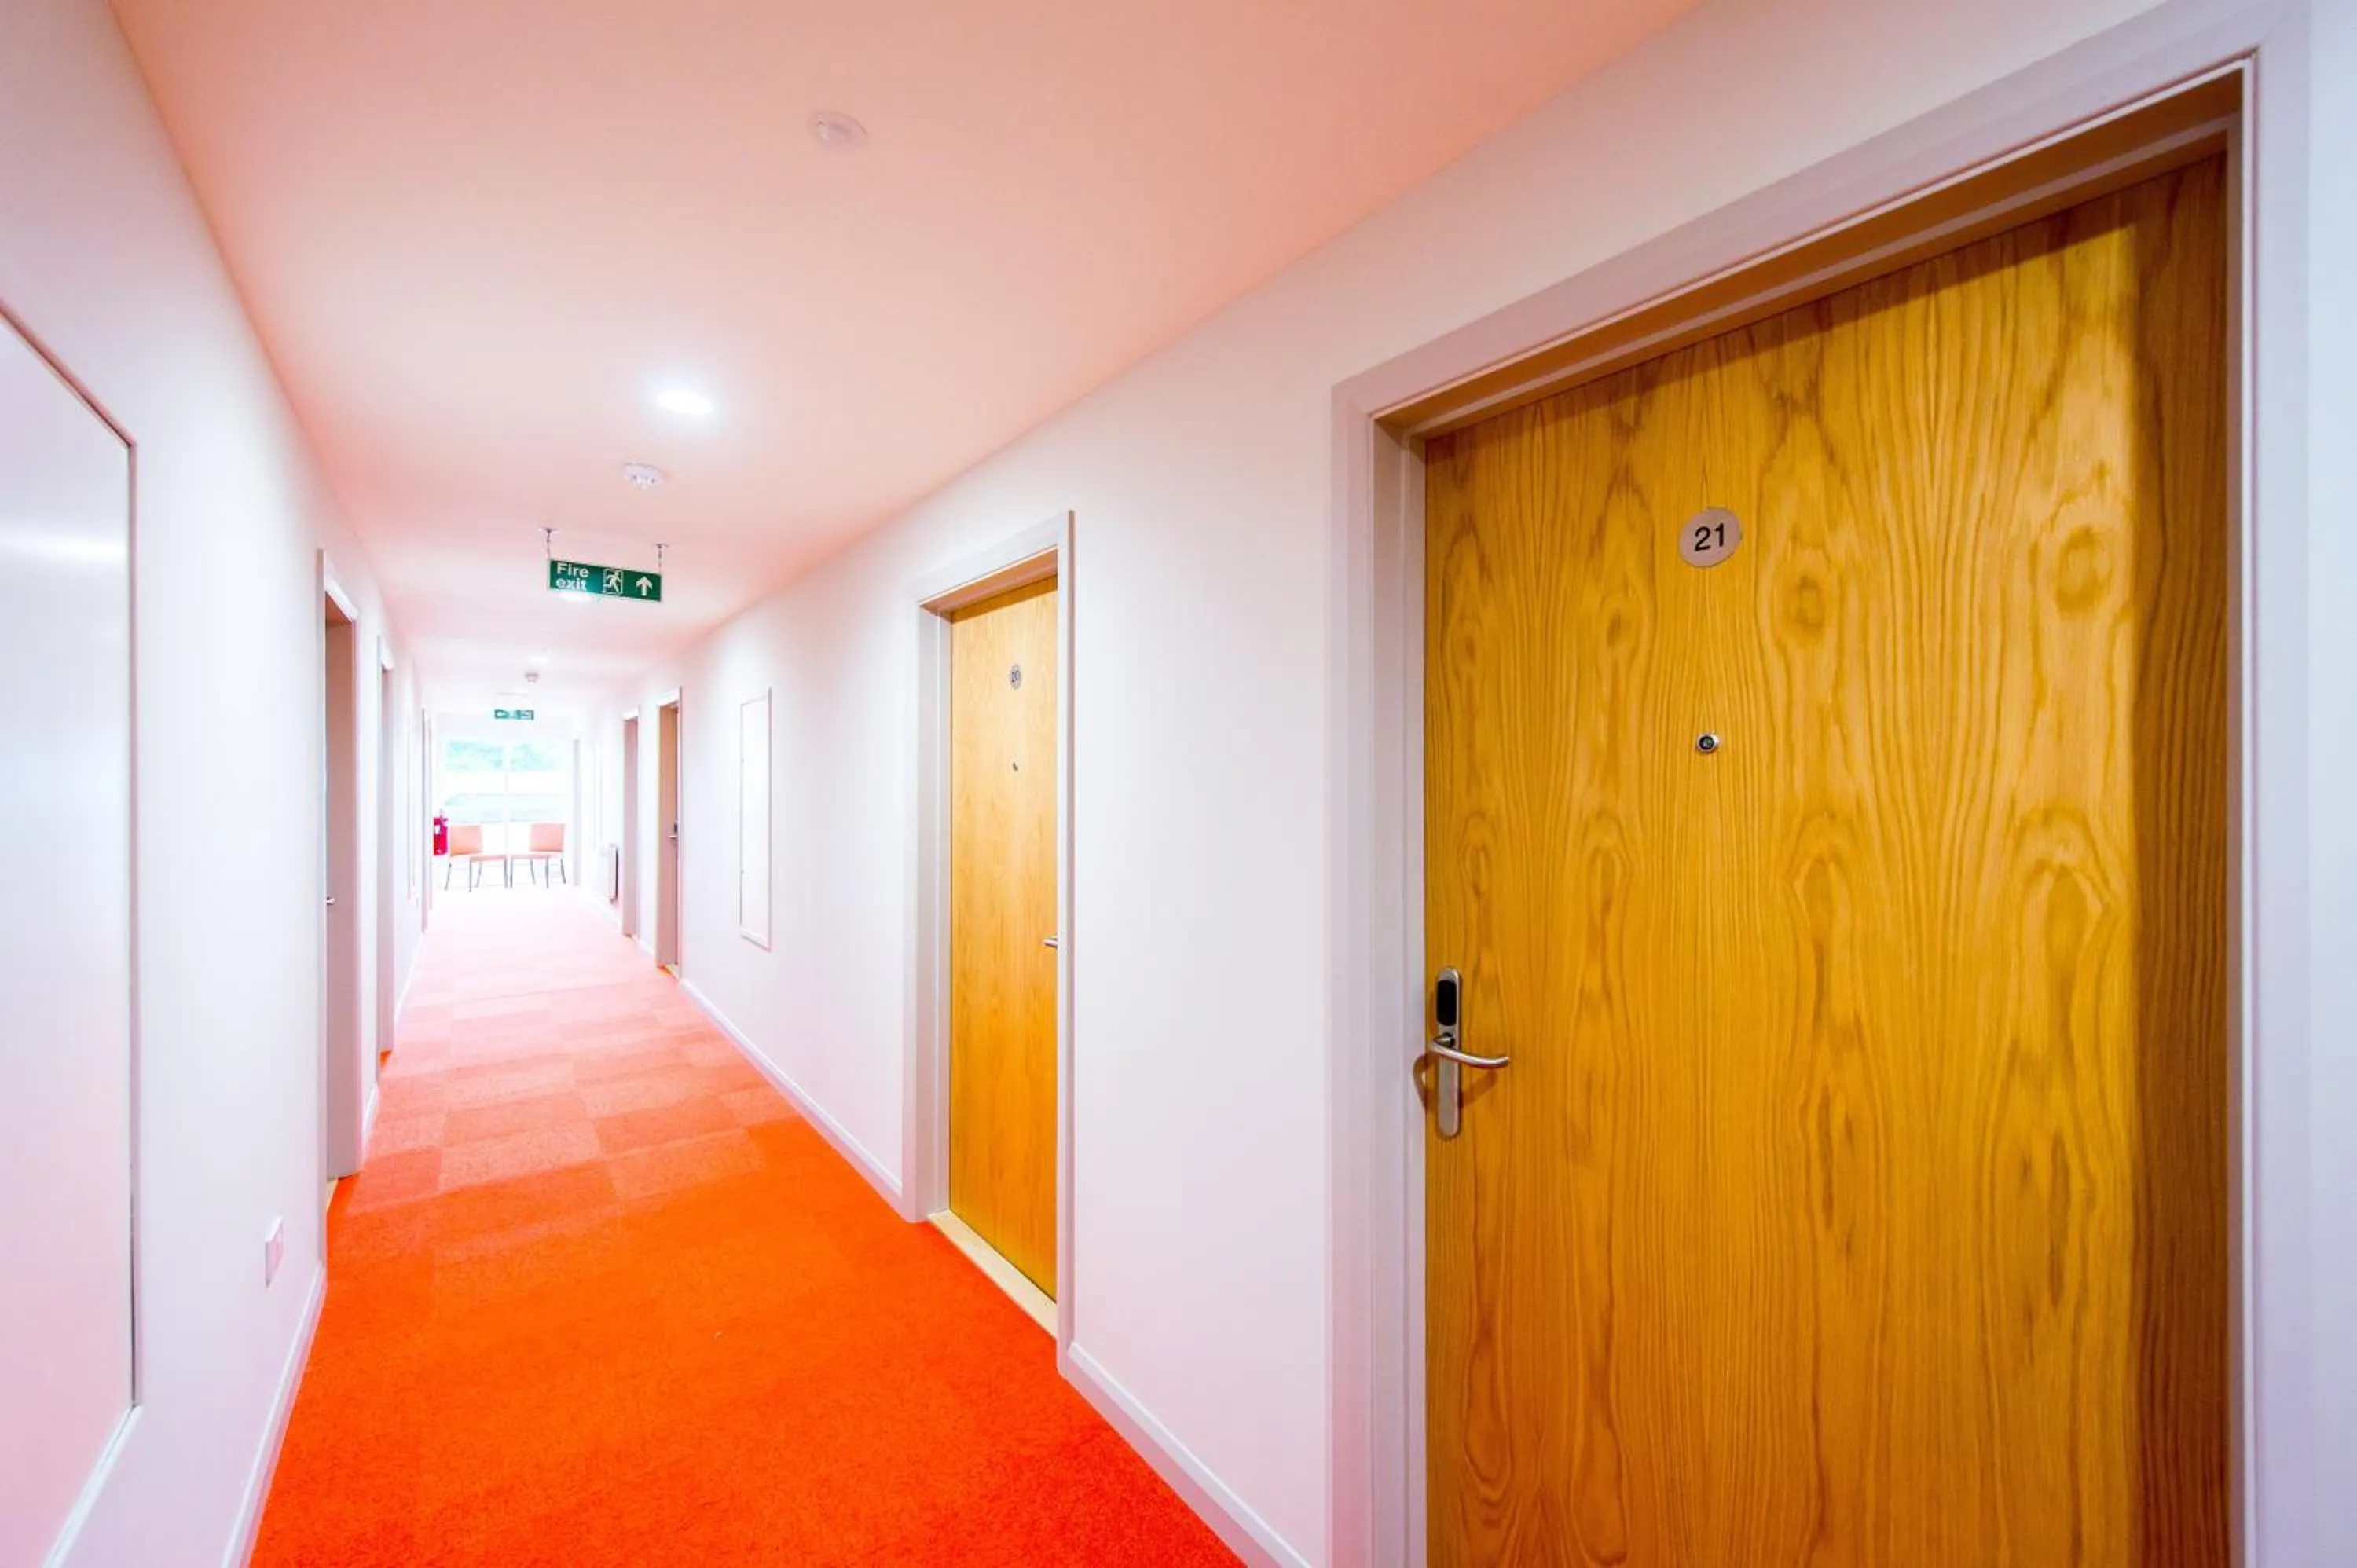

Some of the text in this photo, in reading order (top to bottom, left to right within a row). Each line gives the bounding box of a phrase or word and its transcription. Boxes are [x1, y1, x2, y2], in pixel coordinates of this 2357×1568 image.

[1695, 522, 1725, 551] 21
[557, 562, 589, 577] Fire
[555, 577, 587, 591] exit
